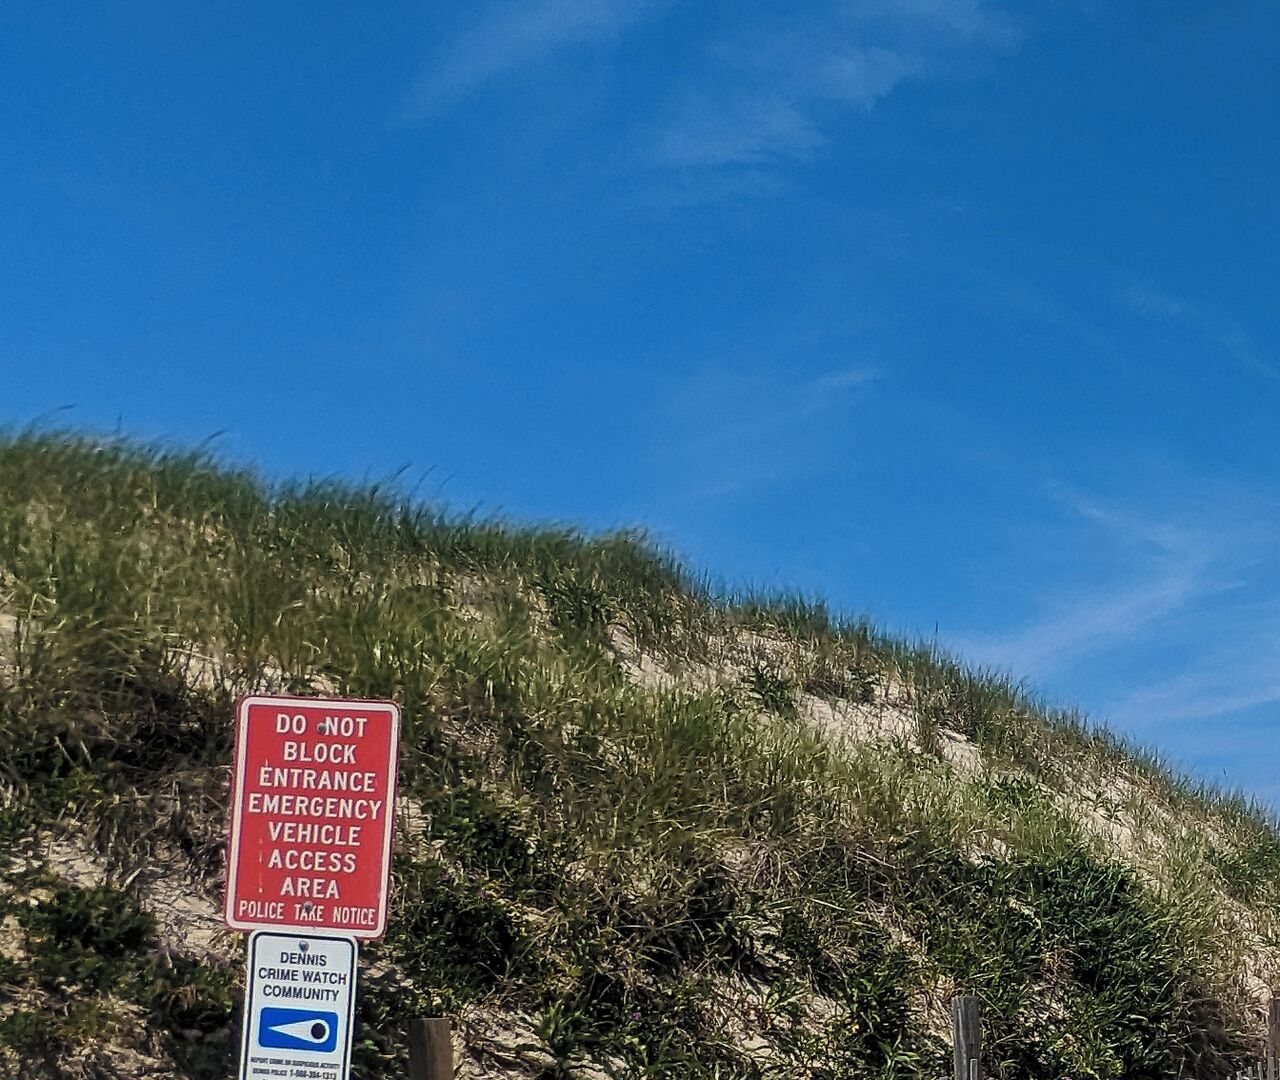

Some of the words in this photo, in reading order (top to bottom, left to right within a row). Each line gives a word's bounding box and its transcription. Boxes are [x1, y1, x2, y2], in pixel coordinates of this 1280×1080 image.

[277, 714, 307, 735] DO
[326, 717, 368, 738] NOT
[284, 742, 356, 764] BLOCK
[260, 766, 376, 792] ENTRANCE
[249, 793, 382, 820] EMERGENCY
[268, 822, 361, 846] VEHICLE
[268, 850, 356, 873] ACCESS
[280, 879, 339, 899] AREA
[239, 901, 284, 919] POLICE
[333, 907, 376, 925] NOTICE
[280, 952, 327, 967] DENNIS
[258, 968, 298, 981] CRIME
[303, 971, 347, 985] WATCH
[263, 984, 339, 1001] COMMUNITY
